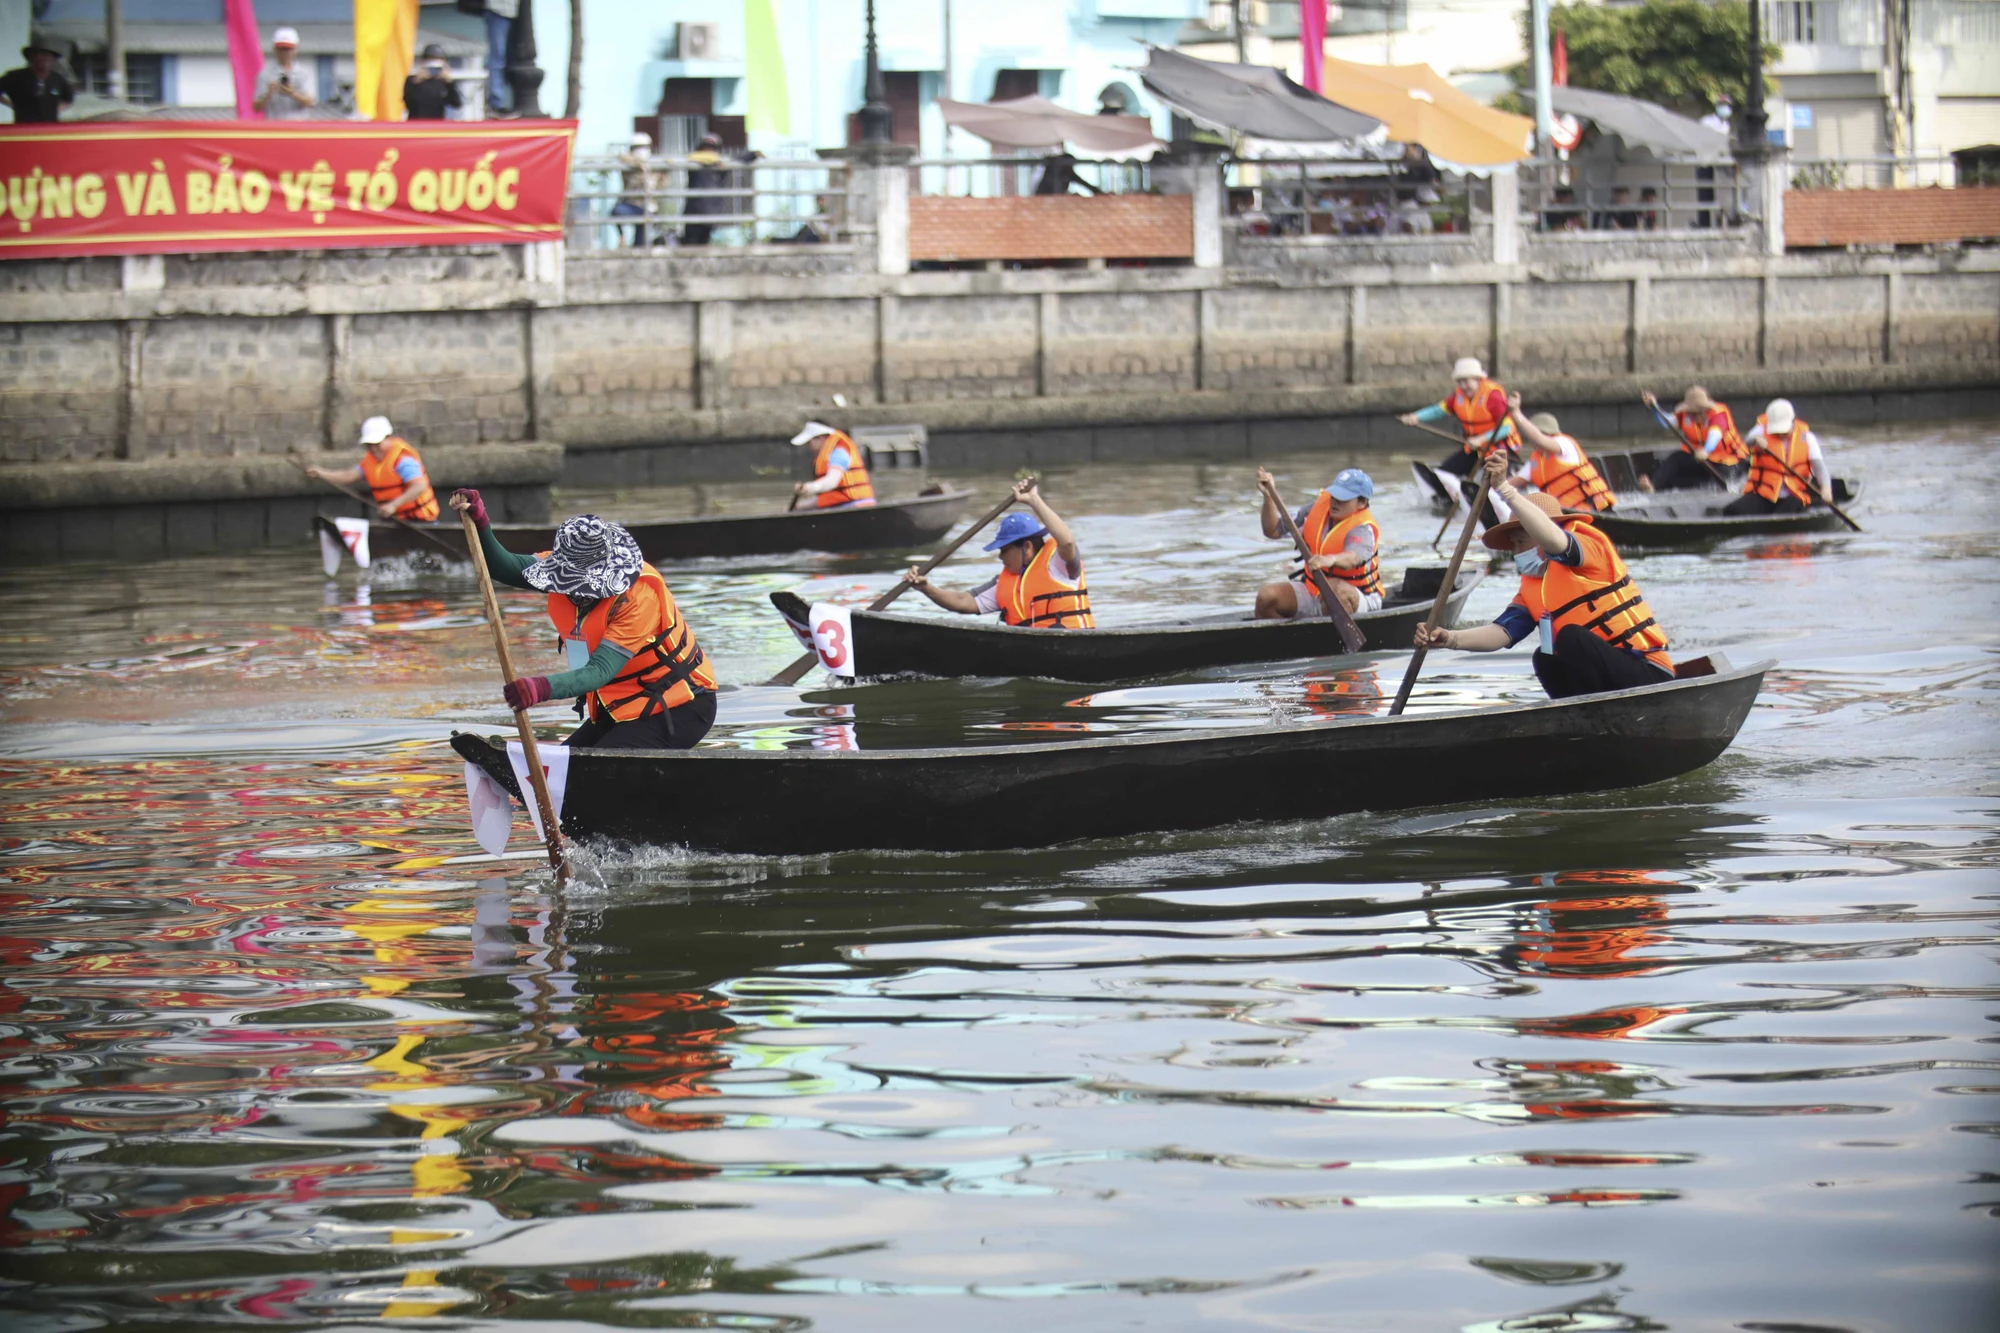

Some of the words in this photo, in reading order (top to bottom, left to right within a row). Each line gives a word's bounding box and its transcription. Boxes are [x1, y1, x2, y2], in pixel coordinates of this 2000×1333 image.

[0, 166, 107, 232] ỰNG
[115, 158, 176, 216] VÀ
[186, 154, 271, 215] BẢO
[280, 160, 335, 224] VỆ
[345, 147, 399, 212] TỔ
[407, 150, 519, 213] QUỐC
[816, 619, 847, 669] 3
